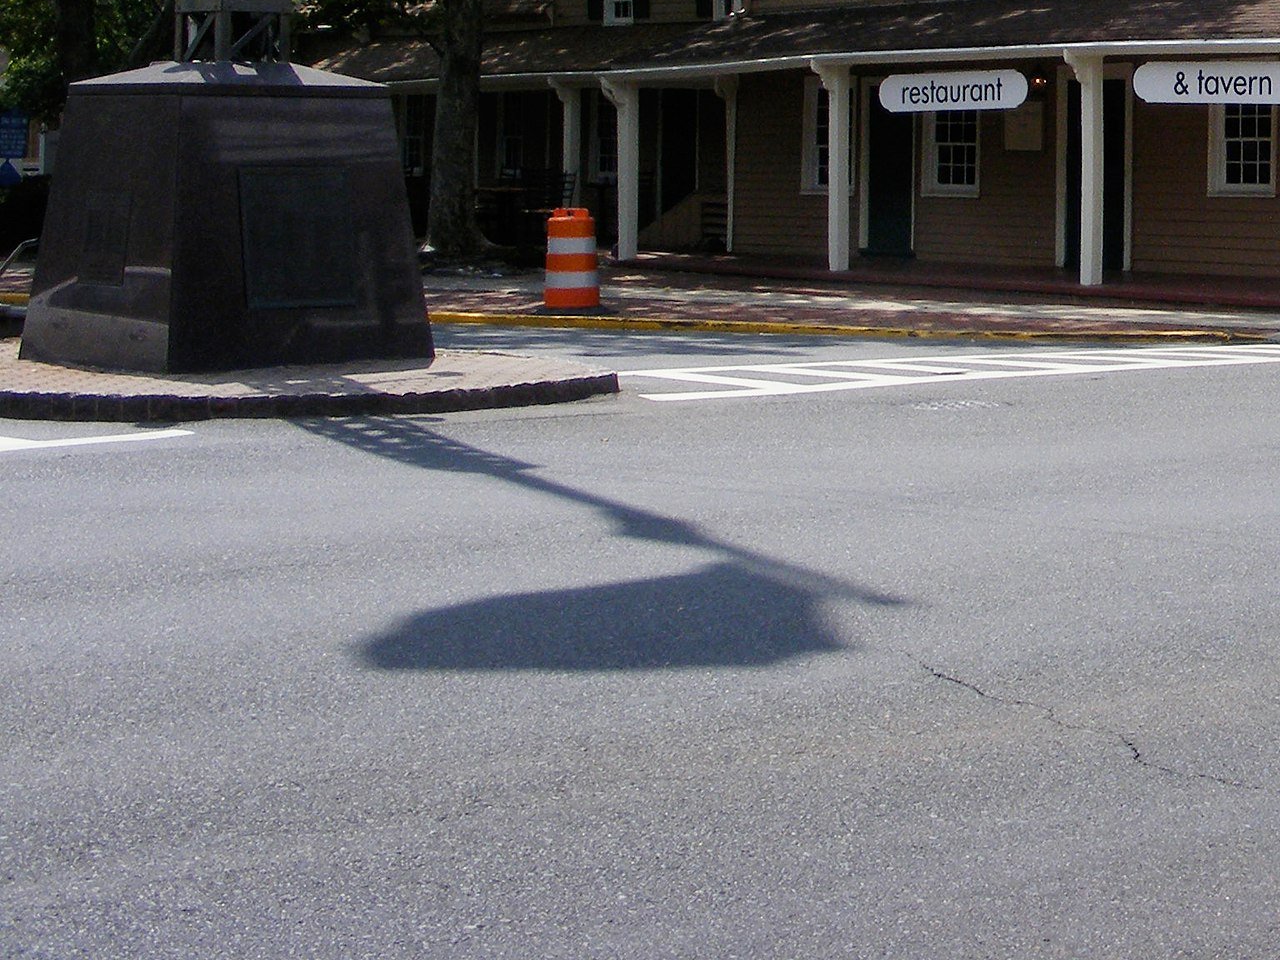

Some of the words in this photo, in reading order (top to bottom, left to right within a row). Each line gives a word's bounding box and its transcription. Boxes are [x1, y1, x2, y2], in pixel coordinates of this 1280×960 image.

[902, 77, 1003, 104] restaurant
[1173, 71, 1189, 95] &
[1197, 69, 1272, 96] tavern
